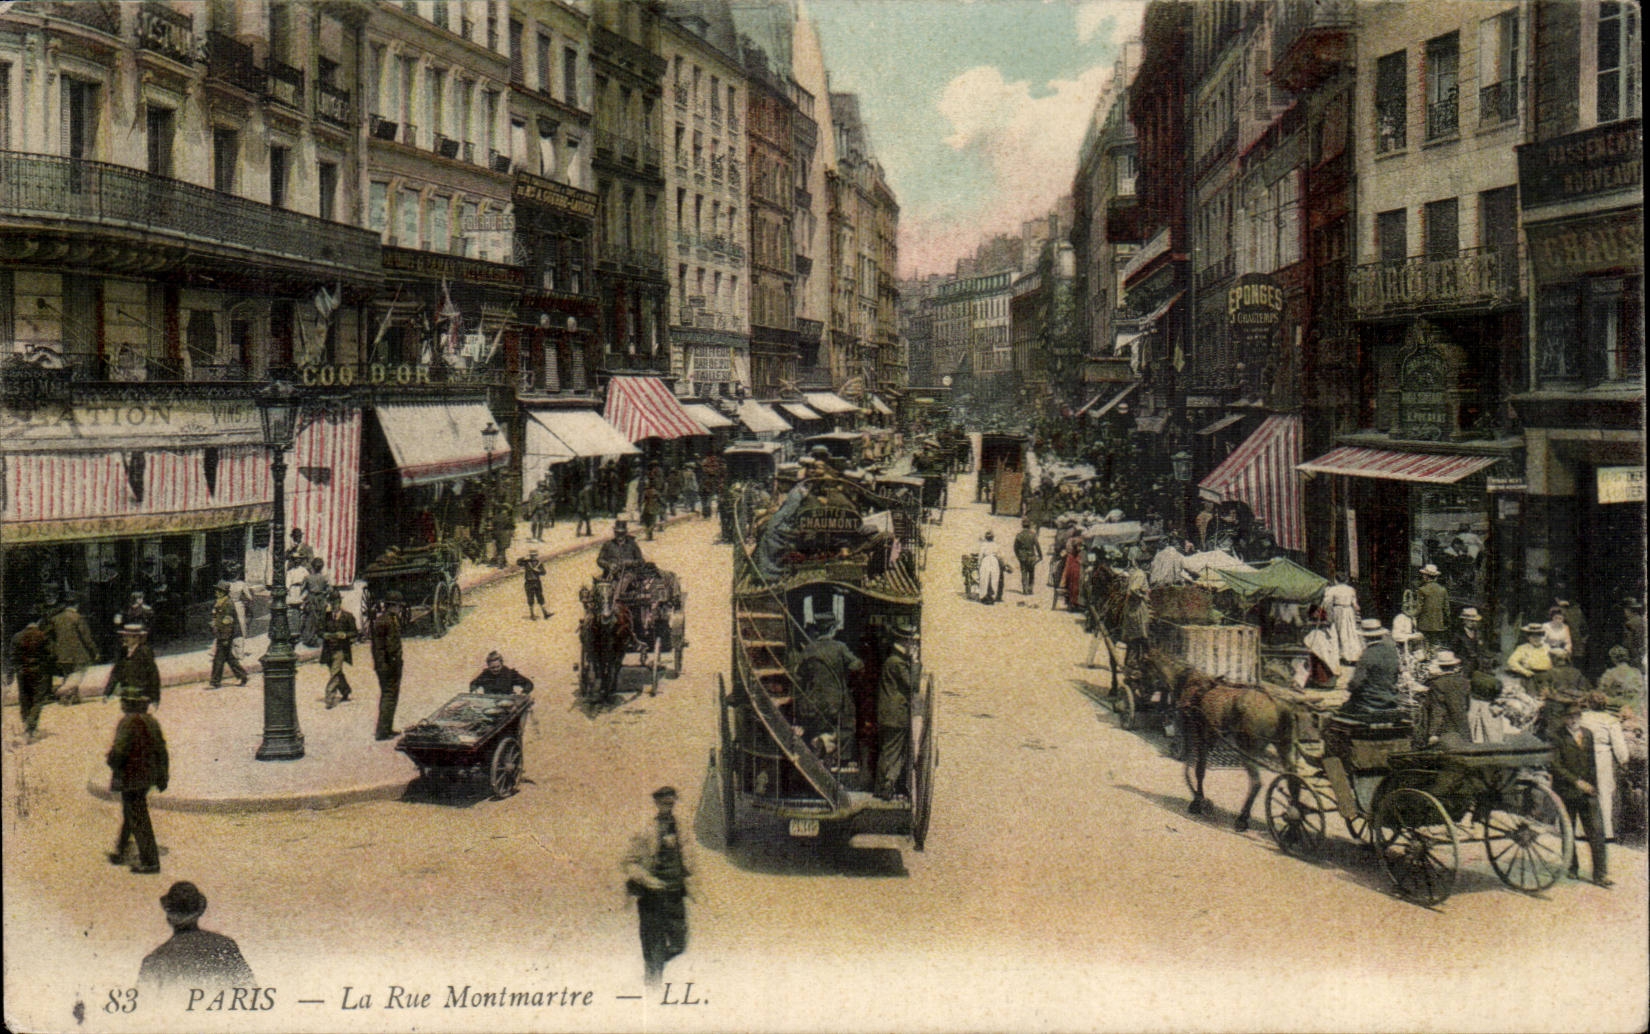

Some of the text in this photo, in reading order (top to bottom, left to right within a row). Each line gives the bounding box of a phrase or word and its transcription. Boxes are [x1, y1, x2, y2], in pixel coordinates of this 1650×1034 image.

[302, 365, 353, 388] COQ
[62, 517, 128, 535] NORD
[800, 517, 859, 530] CHAUMONT
